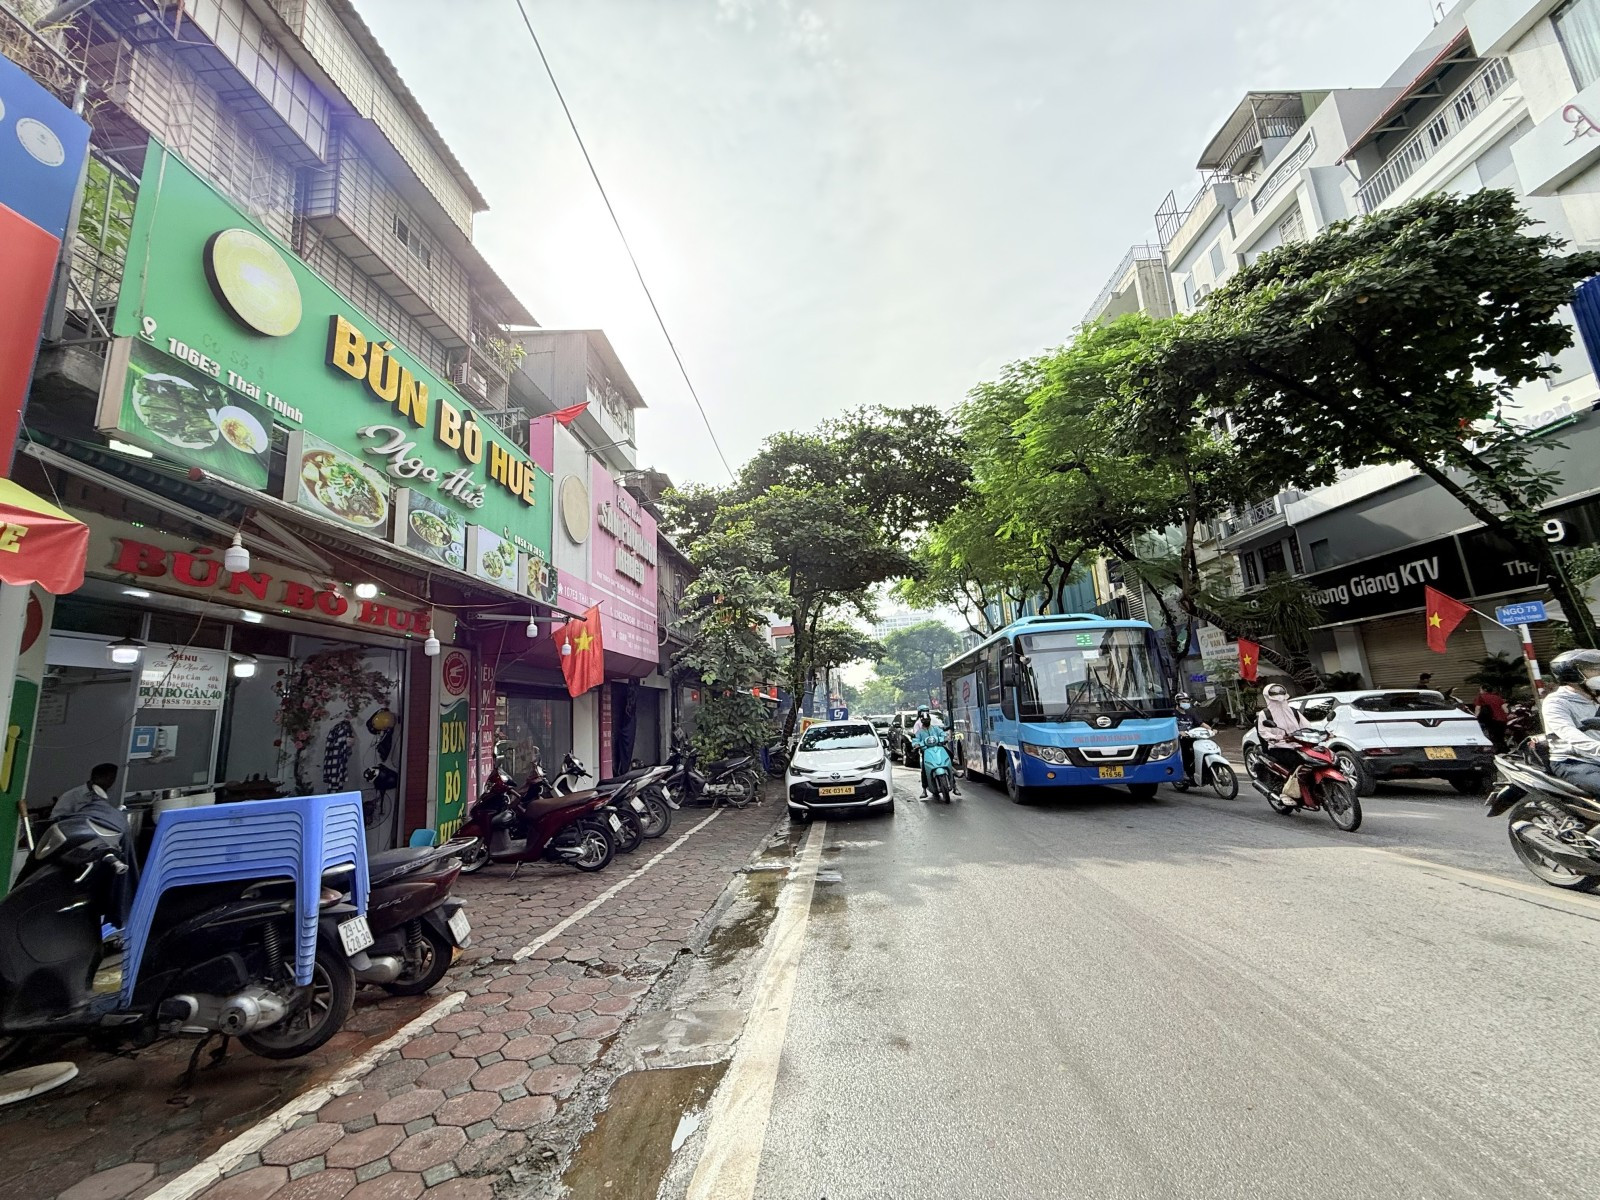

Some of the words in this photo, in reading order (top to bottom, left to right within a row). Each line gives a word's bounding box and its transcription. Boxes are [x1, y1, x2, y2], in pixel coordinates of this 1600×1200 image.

[167, 337, 221, 378] 106E3
[227, 370, 261, 401] Thái
[265, 391, 303, 424] Thịnh
[326, 314, 429, 429] BÚN
[434, 398, 483, 465] BÒ
[0, 520, 29, 554] E
[110, 538, 273, 601] BÚN
[280, 580, 349, 617] BÒ
[1350, 571, 1400, 596] Giang
[1399, 556, 1439, 587] KTV
[1502, 605, 1525, 616] NGÕ
[1525, 605, 1538, 614] 79
[171, 653, 198, 662] MENU
[165, 687, 183, 698] BÒ
[441, 712, 467, 754] BÚN
[445, 760, 461, 804] BÒ
[343, 918, 365, 938] 29-L1
